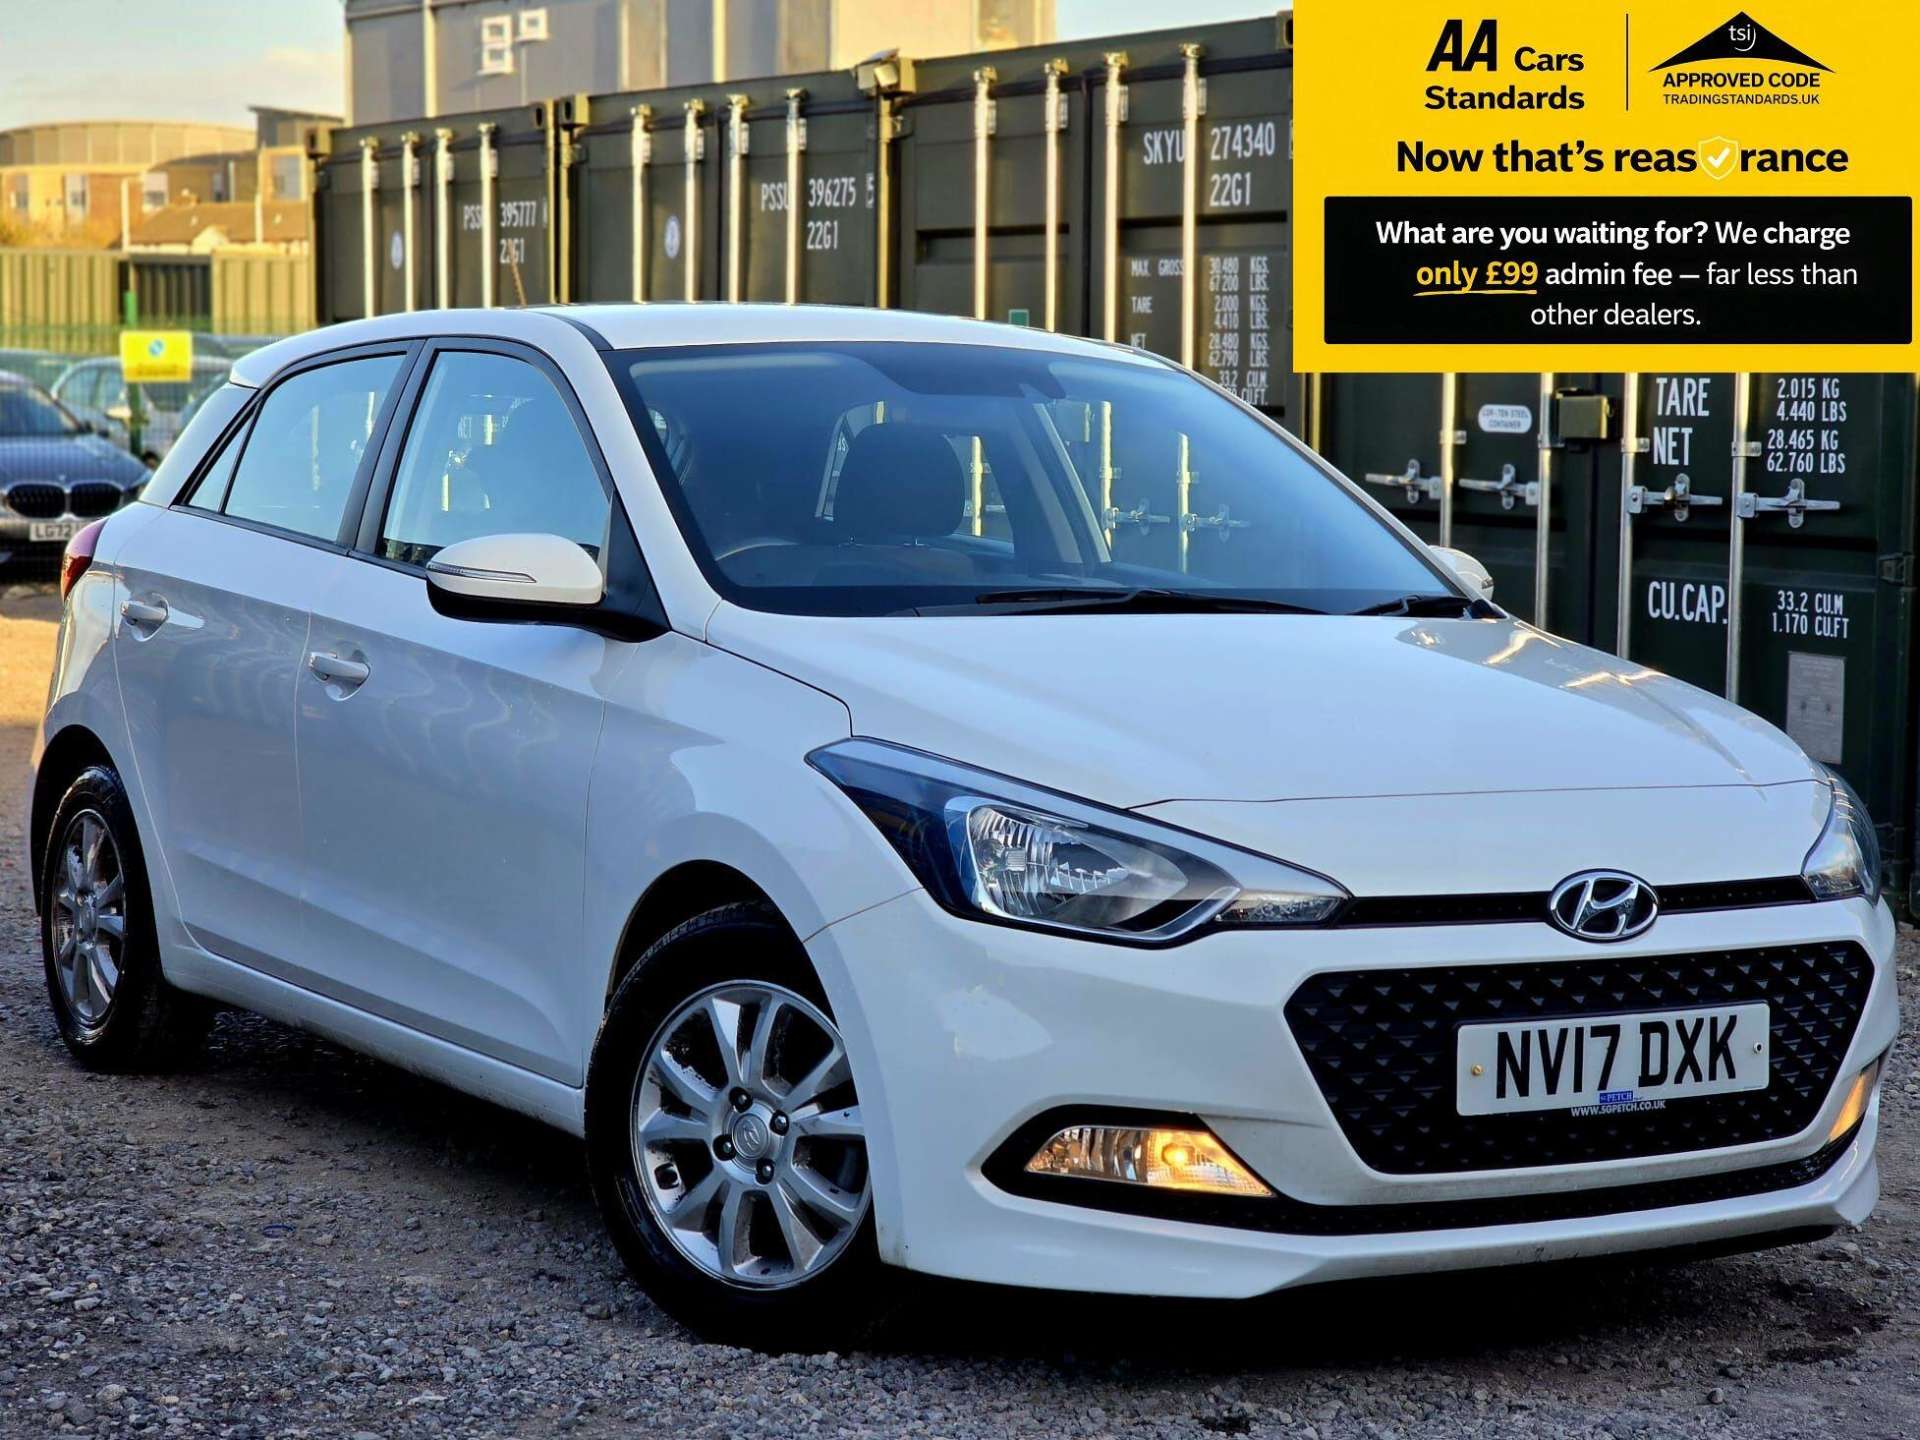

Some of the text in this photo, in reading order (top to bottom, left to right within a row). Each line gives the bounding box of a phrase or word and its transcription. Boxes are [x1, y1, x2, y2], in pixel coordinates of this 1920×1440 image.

[1143, 129, 1186, 165] SKYU
[1210, 122, 1276, 161] 274340
[808, 177, 856, 208] 396275
[1209, 171, 1251, 206] 22G1
[463, 204, 484, 231] PSS
[500, 201, 537, 227] 395777
[806, 220, 838, 250] 22G1
[1656, 378, 1840, 417] TARE 2.015 KG
[1776, 401, 1847, 422] 4.440 LBS
[1653, 426, 1839, 466] NET 28.465 KG
[1767, 452, 1846, 474] 62.760 LBS
[35, 522, 73, 538] LG72
[1648, 581, 1844, 625] CU.CAP. 33.2 CU.M
[1772, 612, 1849, 639] 1.170 CU.FT
[1496, 1015, 1738, 1099] NV17 DXK
[1570, 1100, 1667, 1118] WWW.SGPETCH.CO.UK
